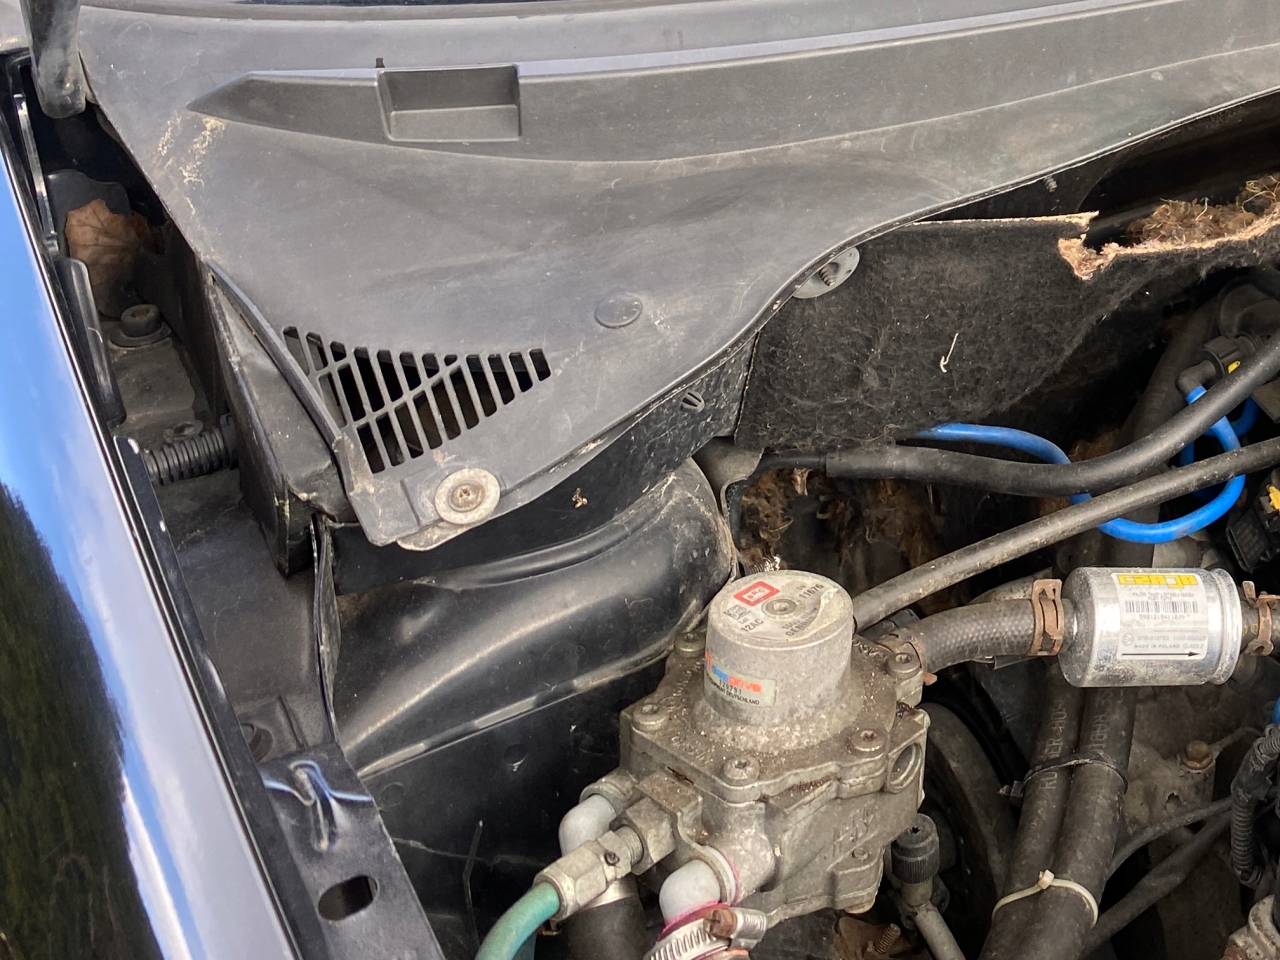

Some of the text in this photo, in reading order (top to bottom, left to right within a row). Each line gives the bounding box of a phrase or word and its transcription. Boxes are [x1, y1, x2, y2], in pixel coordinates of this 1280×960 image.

[746, 587, 767, 600] BRC
[725, 689, 760, 706] DEUTSCHLAND
[1040, 737, 1064, 790] RUER
